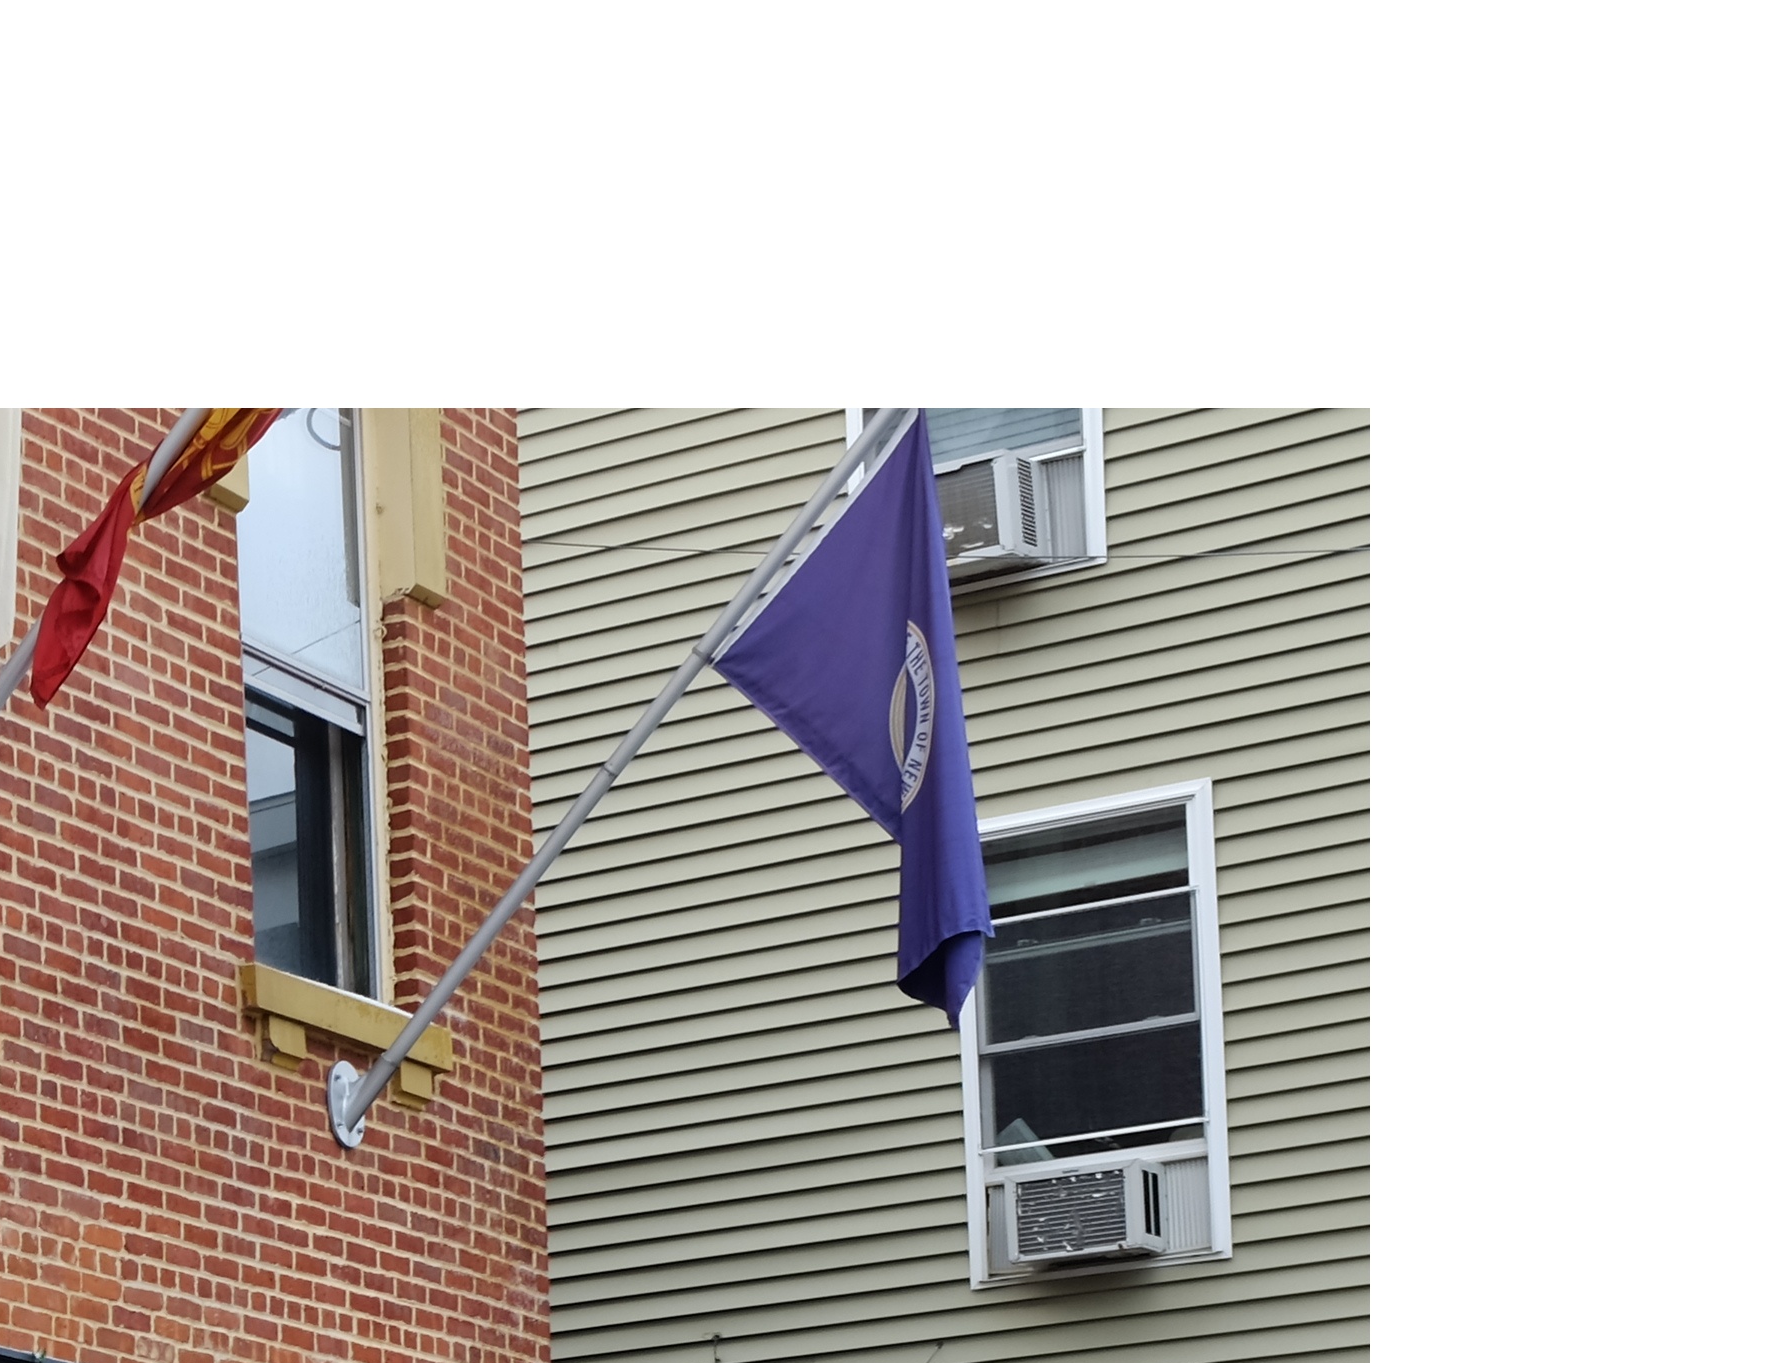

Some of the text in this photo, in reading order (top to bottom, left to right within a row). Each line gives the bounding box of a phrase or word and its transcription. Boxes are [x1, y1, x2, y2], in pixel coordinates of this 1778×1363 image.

[906, 641, 927, 676] THE
[917, 673, 931, 724] TOWN
[915, 731, 928, 752] OF
